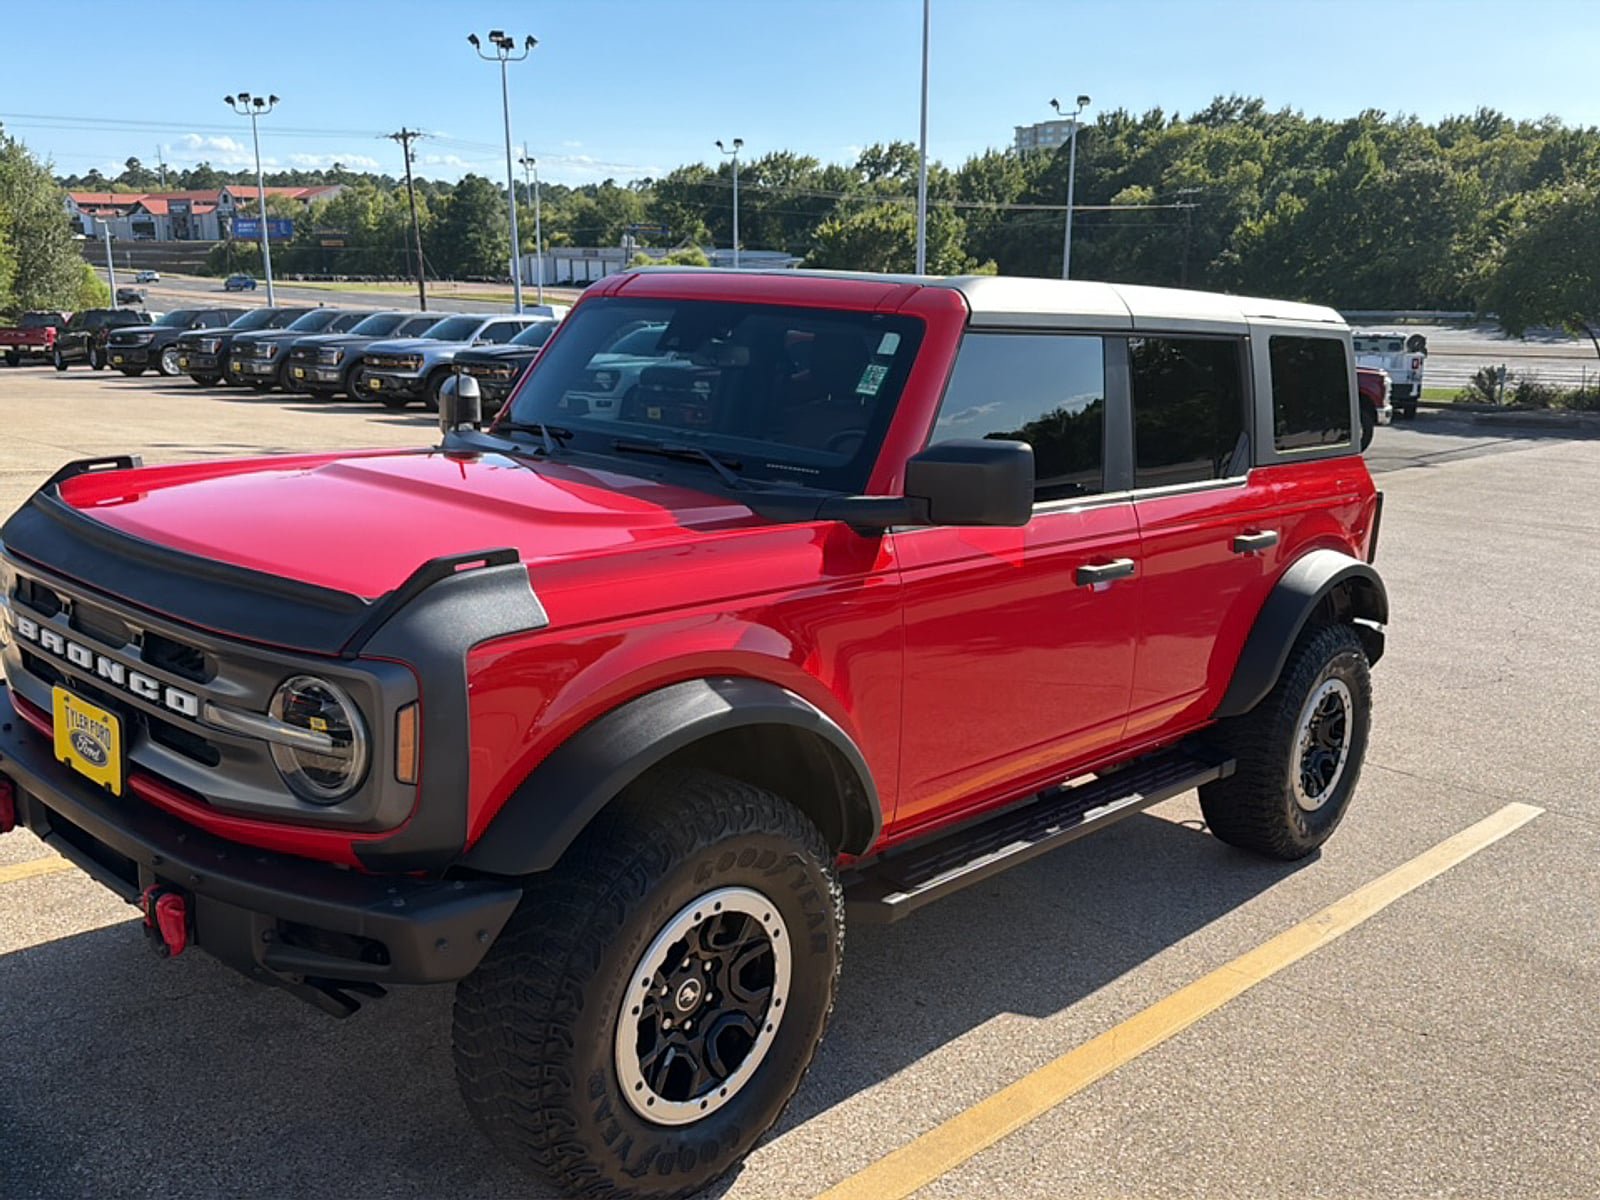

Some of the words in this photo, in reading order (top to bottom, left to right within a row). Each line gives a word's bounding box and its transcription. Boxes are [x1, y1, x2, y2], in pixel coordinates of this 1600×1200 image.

[18, 616, 198, 717] BRONCO
[65, 704, 88, 730] TYLER
[90, 719, 111, 752] FORD
[76, 734, 101, 761] Ford
